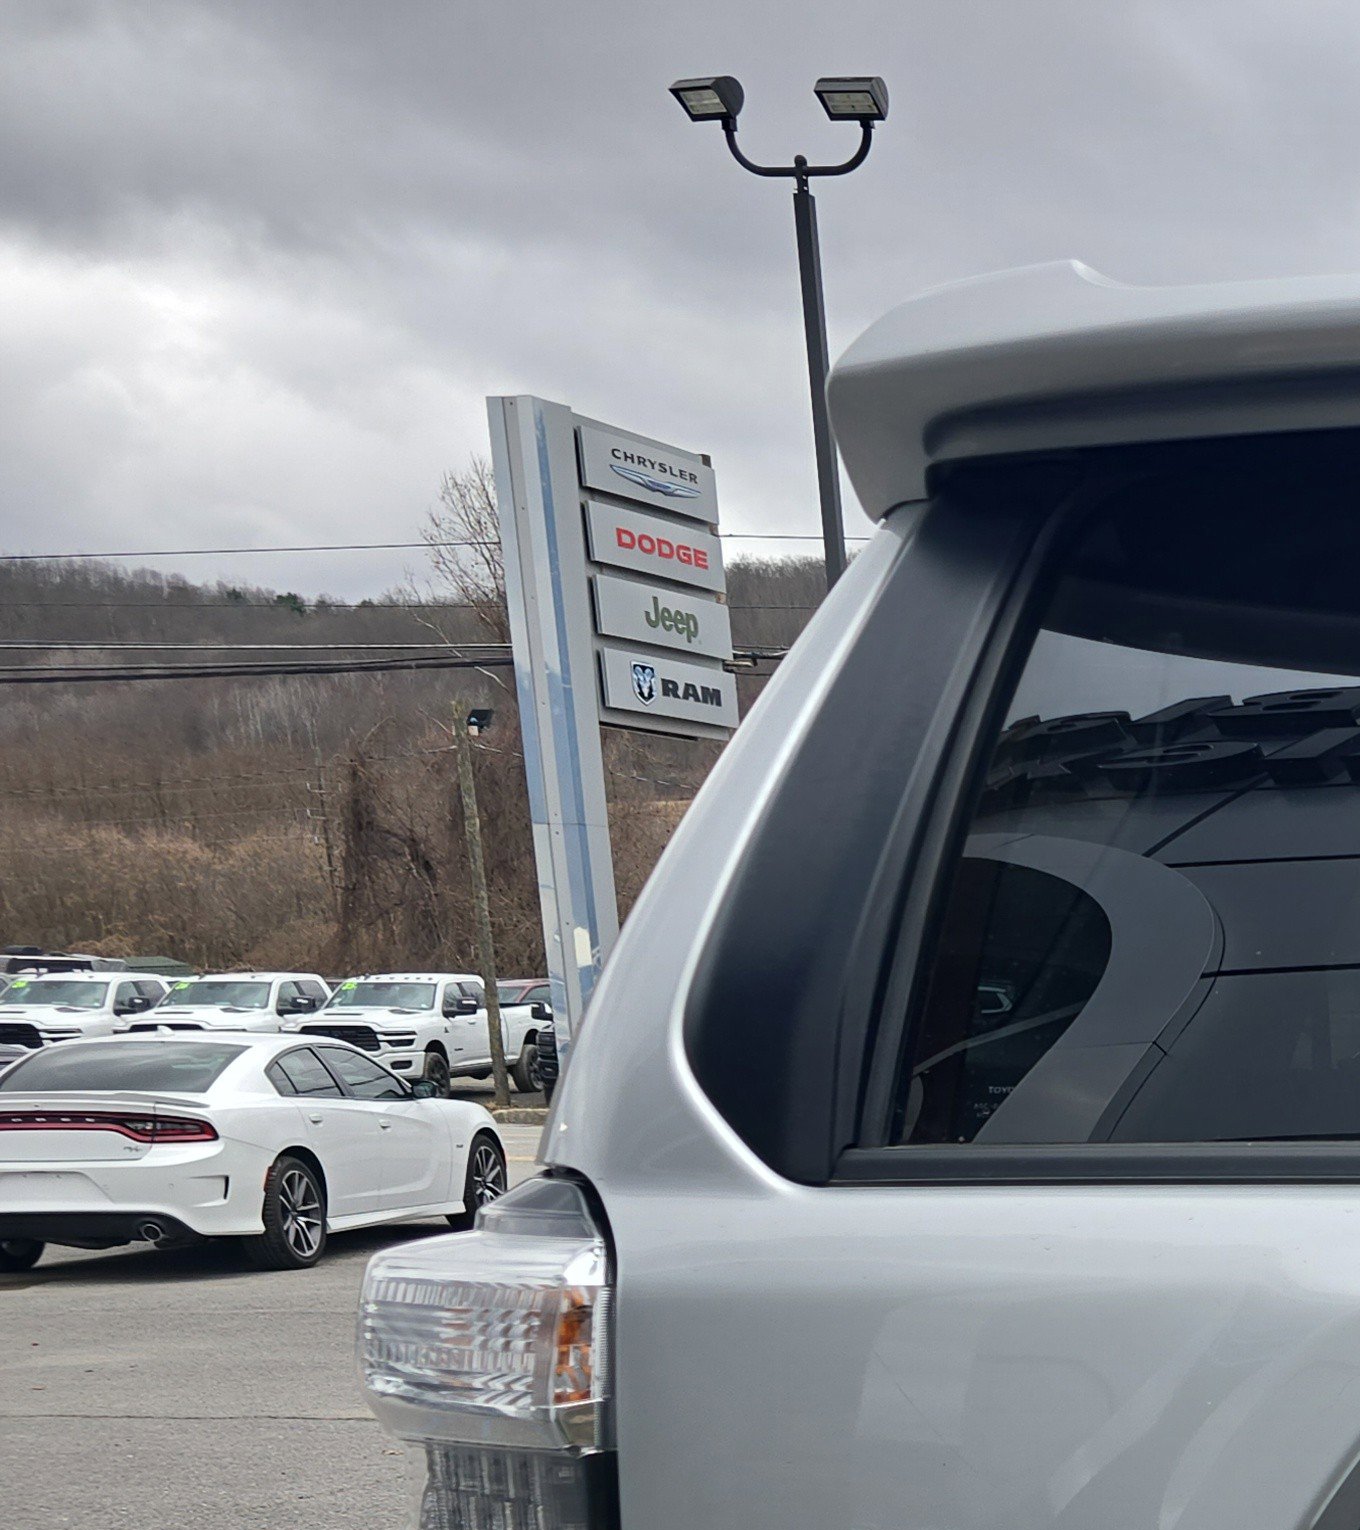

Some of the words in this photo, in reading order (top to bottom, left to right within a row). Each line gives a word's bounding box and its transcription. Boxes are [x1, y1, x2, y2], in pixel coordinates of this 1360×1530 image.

[610, 447, 700, 485] CHRYSLER
[615, 527, 709, 570] DODGE
[644, 596, 699, 644] Jeep
[661, 678, 723, 708] RAM
